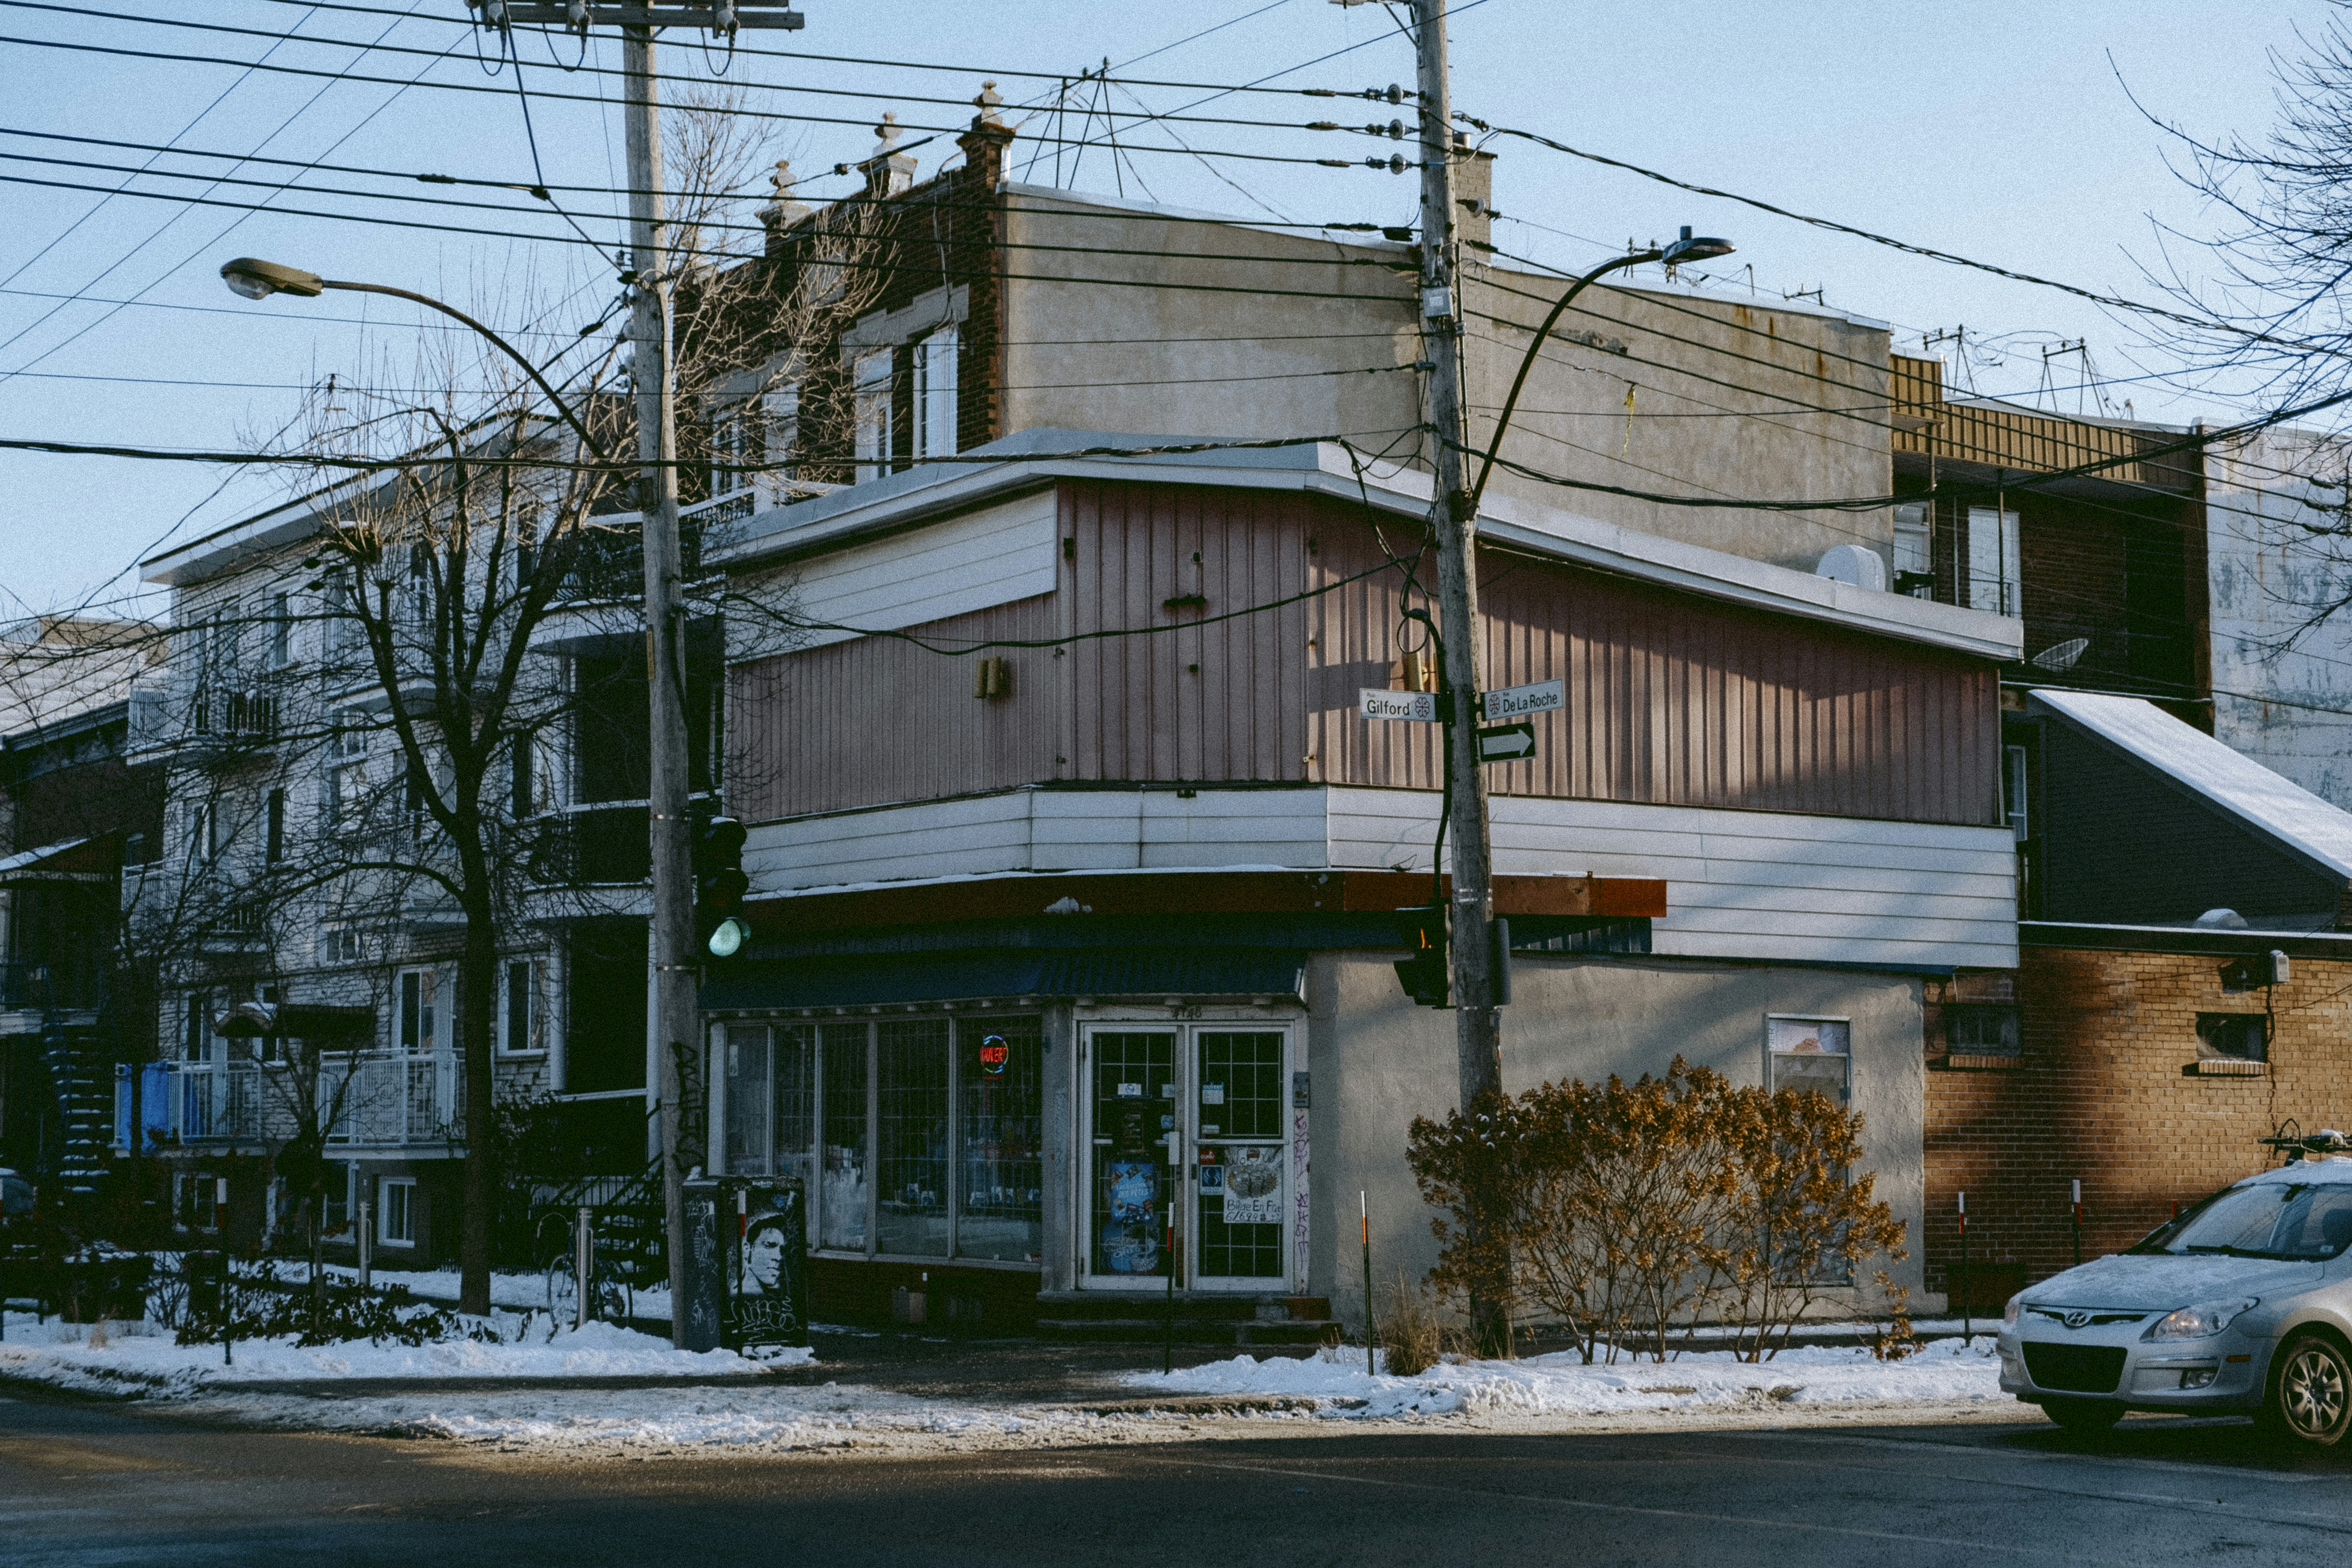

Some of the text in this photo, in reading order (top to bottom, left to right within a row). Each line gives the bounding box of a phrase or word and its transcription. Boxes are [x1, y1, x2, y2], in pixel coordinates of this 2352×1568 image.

[1367, 699, 1410, 716] Gilford
[1503, 692, 1557, 713] De La Roche
[1227, 1199, 1251, 1211] Bière
[1253, 1200, 1264, 1213] En
